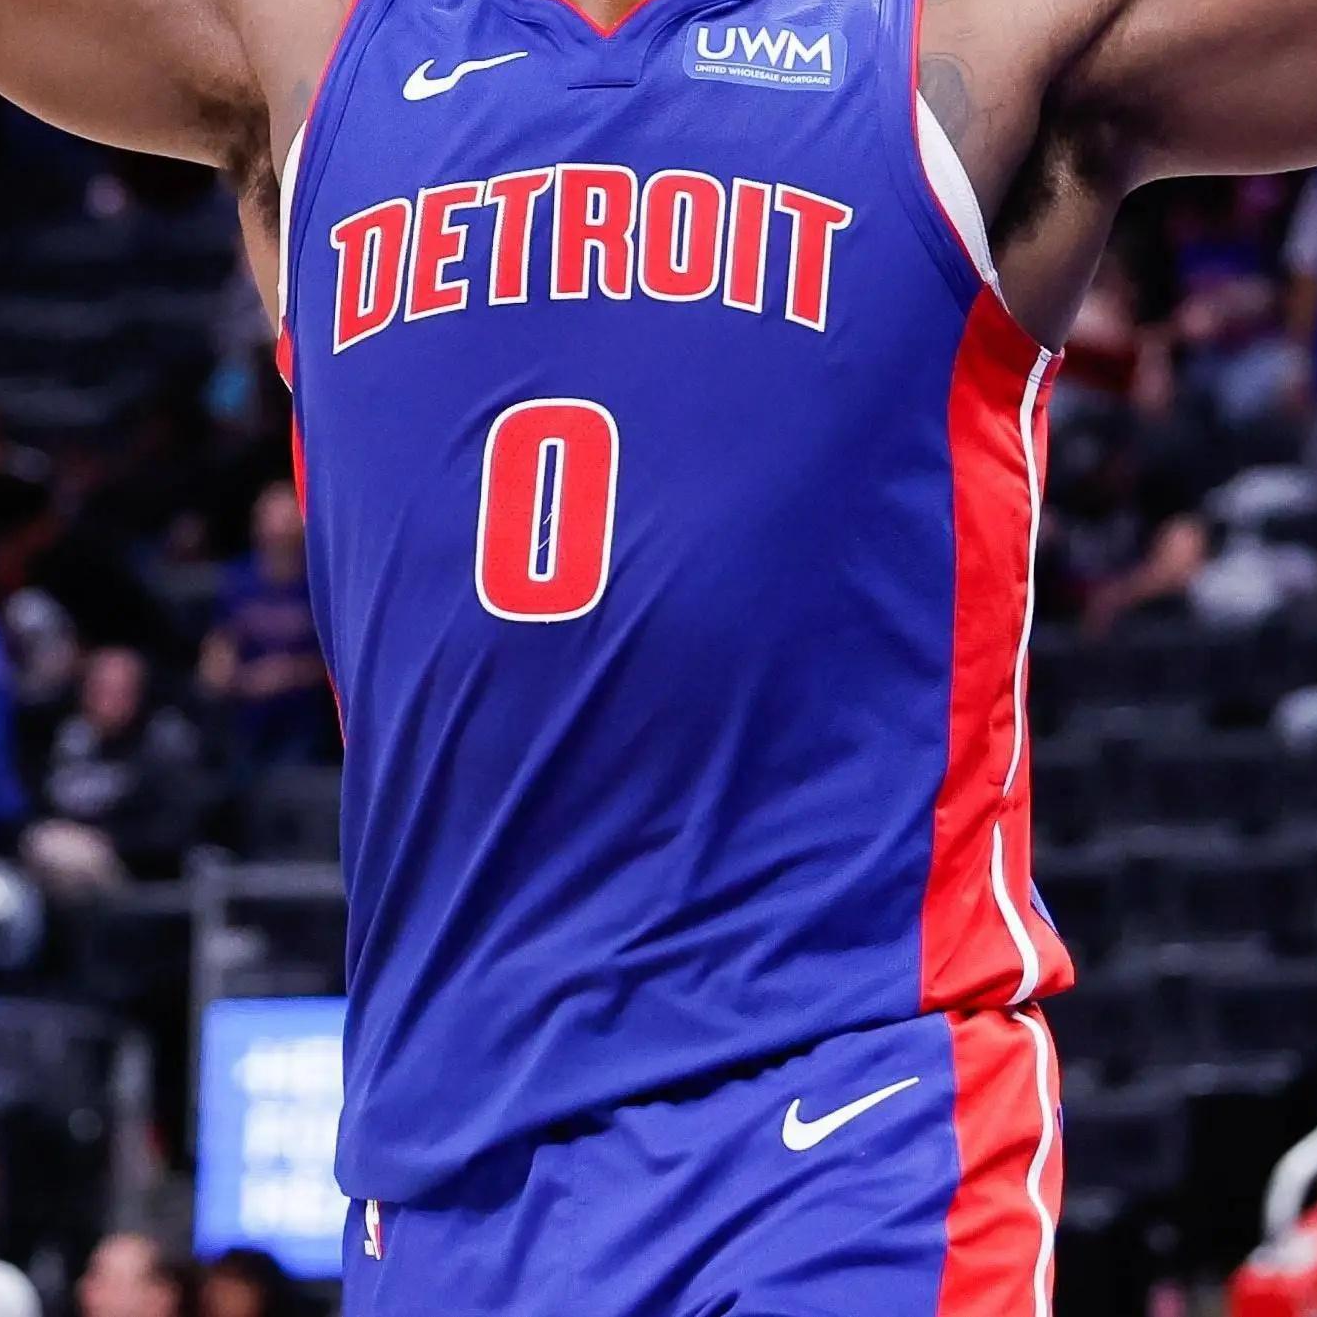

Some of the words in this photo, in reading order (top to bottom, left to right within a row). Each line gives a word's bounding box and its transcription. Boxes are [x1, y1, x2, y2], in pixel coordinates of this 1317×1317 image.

[695, 64, 727, 75] UNITED
[729, 67, 780, 82] WHOLESALE
[781, 75, 831, 85] MORTGAGE
[697, 27, 831, 71] UWM
[330, 162, 853, 355] DETROIT
[475, 398, 619, 621] 0
